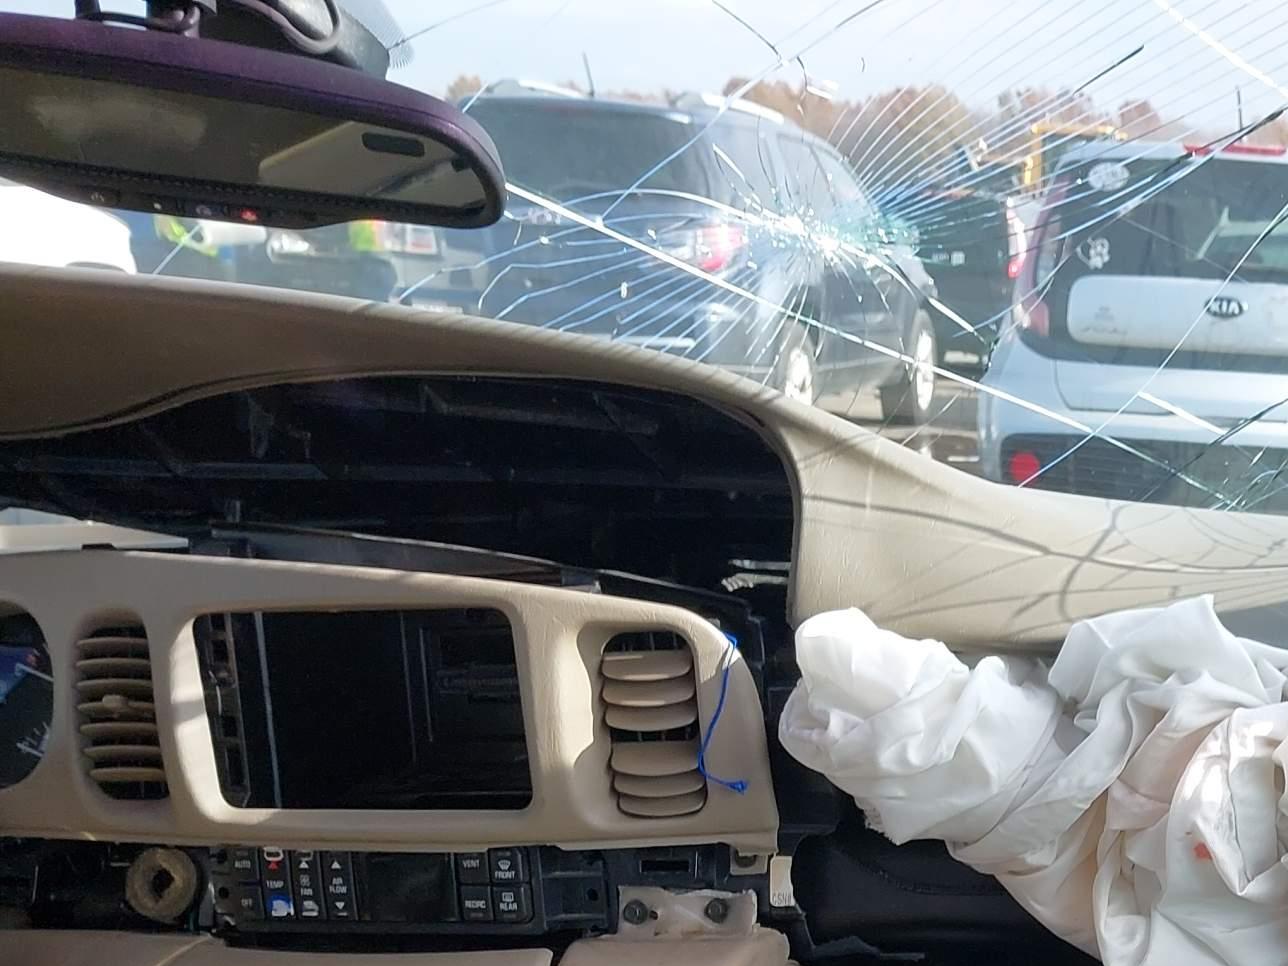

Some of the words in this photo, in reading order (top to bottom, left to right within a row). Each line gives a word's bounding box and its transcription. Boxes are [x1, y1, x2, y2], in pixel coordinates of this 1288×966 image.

[462, 859, 480, 869] VENT
[494, 870, 516, 879] FRONT
[266, 880, 284, 889] TEMP
[500, 902, 518, 911] REAR
